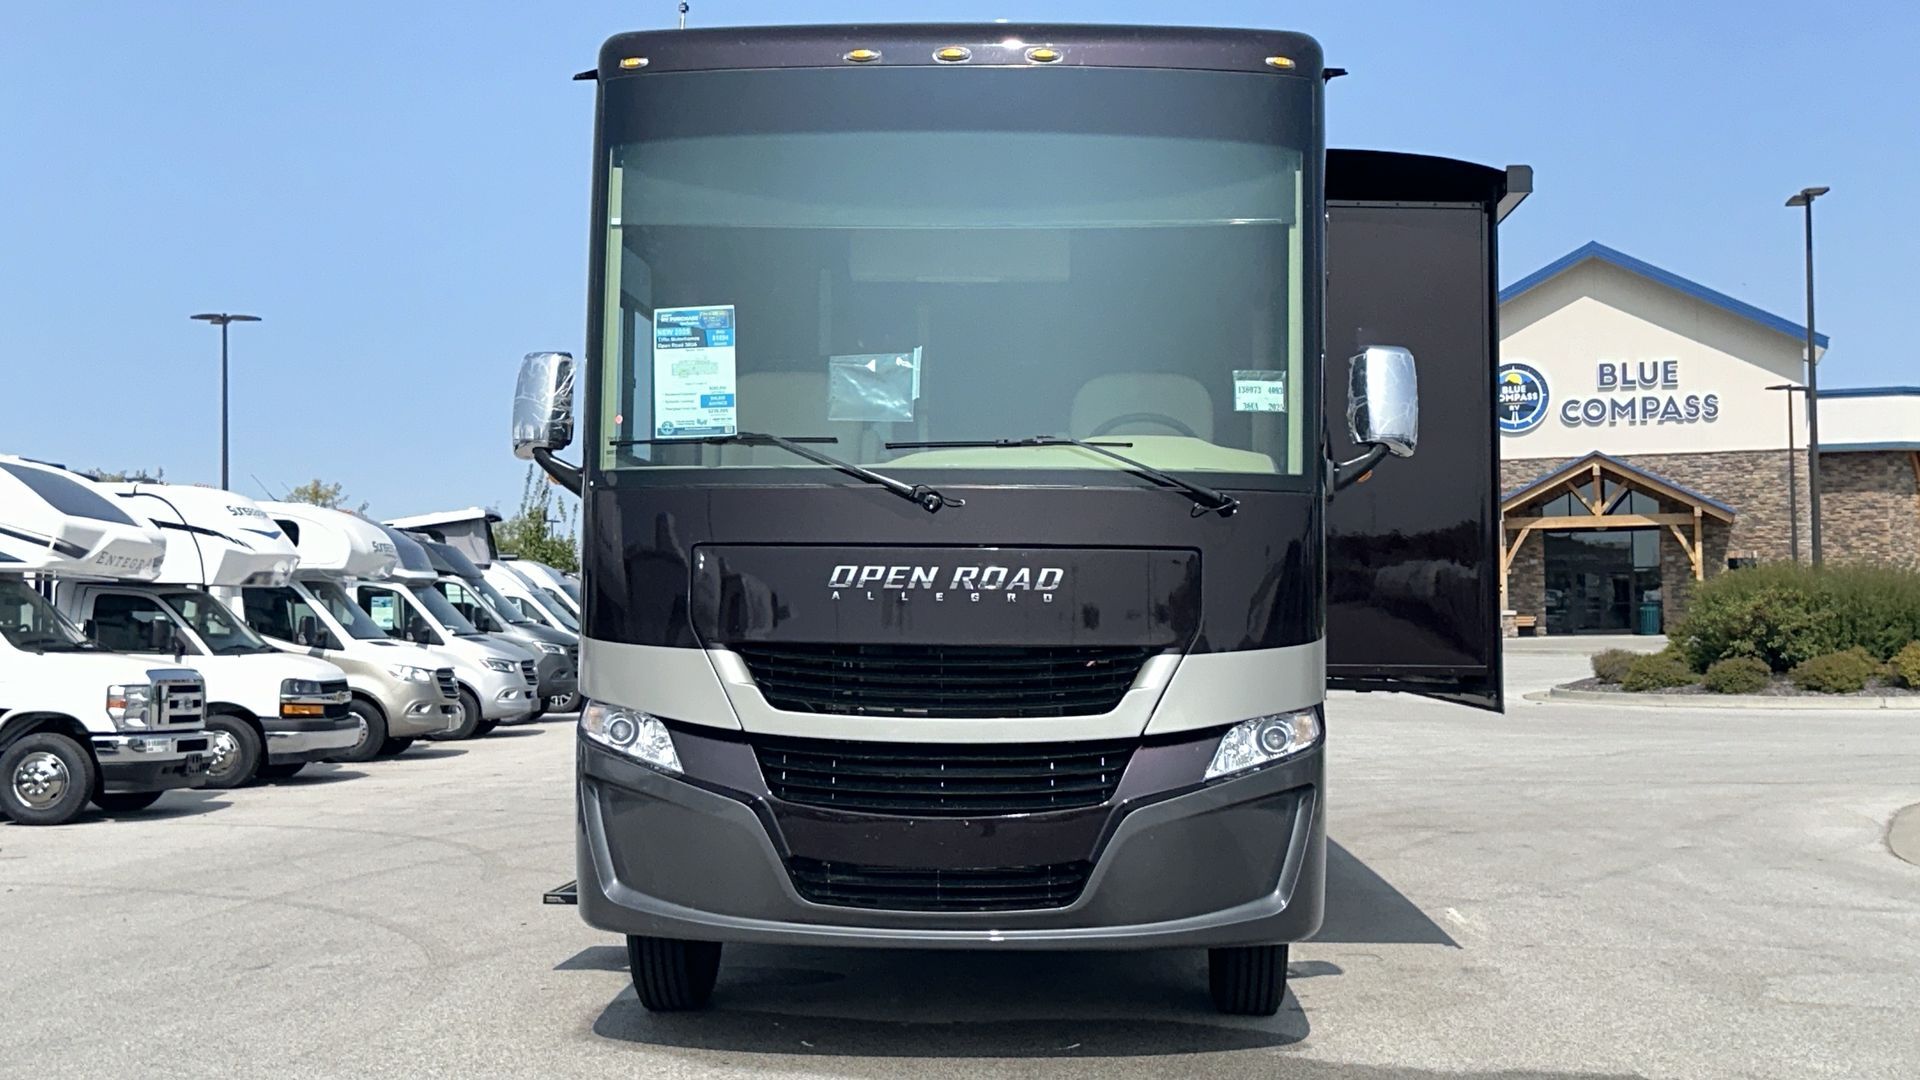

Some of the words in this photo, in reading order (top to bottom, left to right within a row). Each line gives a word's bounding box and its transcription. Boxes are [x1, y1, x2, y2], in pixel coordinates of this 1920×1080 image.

[1598, 360, 1678, 390] BLUE
[1499, 392, 1538, 402] OMPASS
[1502, 385, 1526, 394] BLUE
[1560, 394, 1719, 425] COMPASS
[828, 565, 939, 589] OPEN
[950, 566, 1064, 591] ROAD
[831, 590, 1053, 603] ALLEGRO
